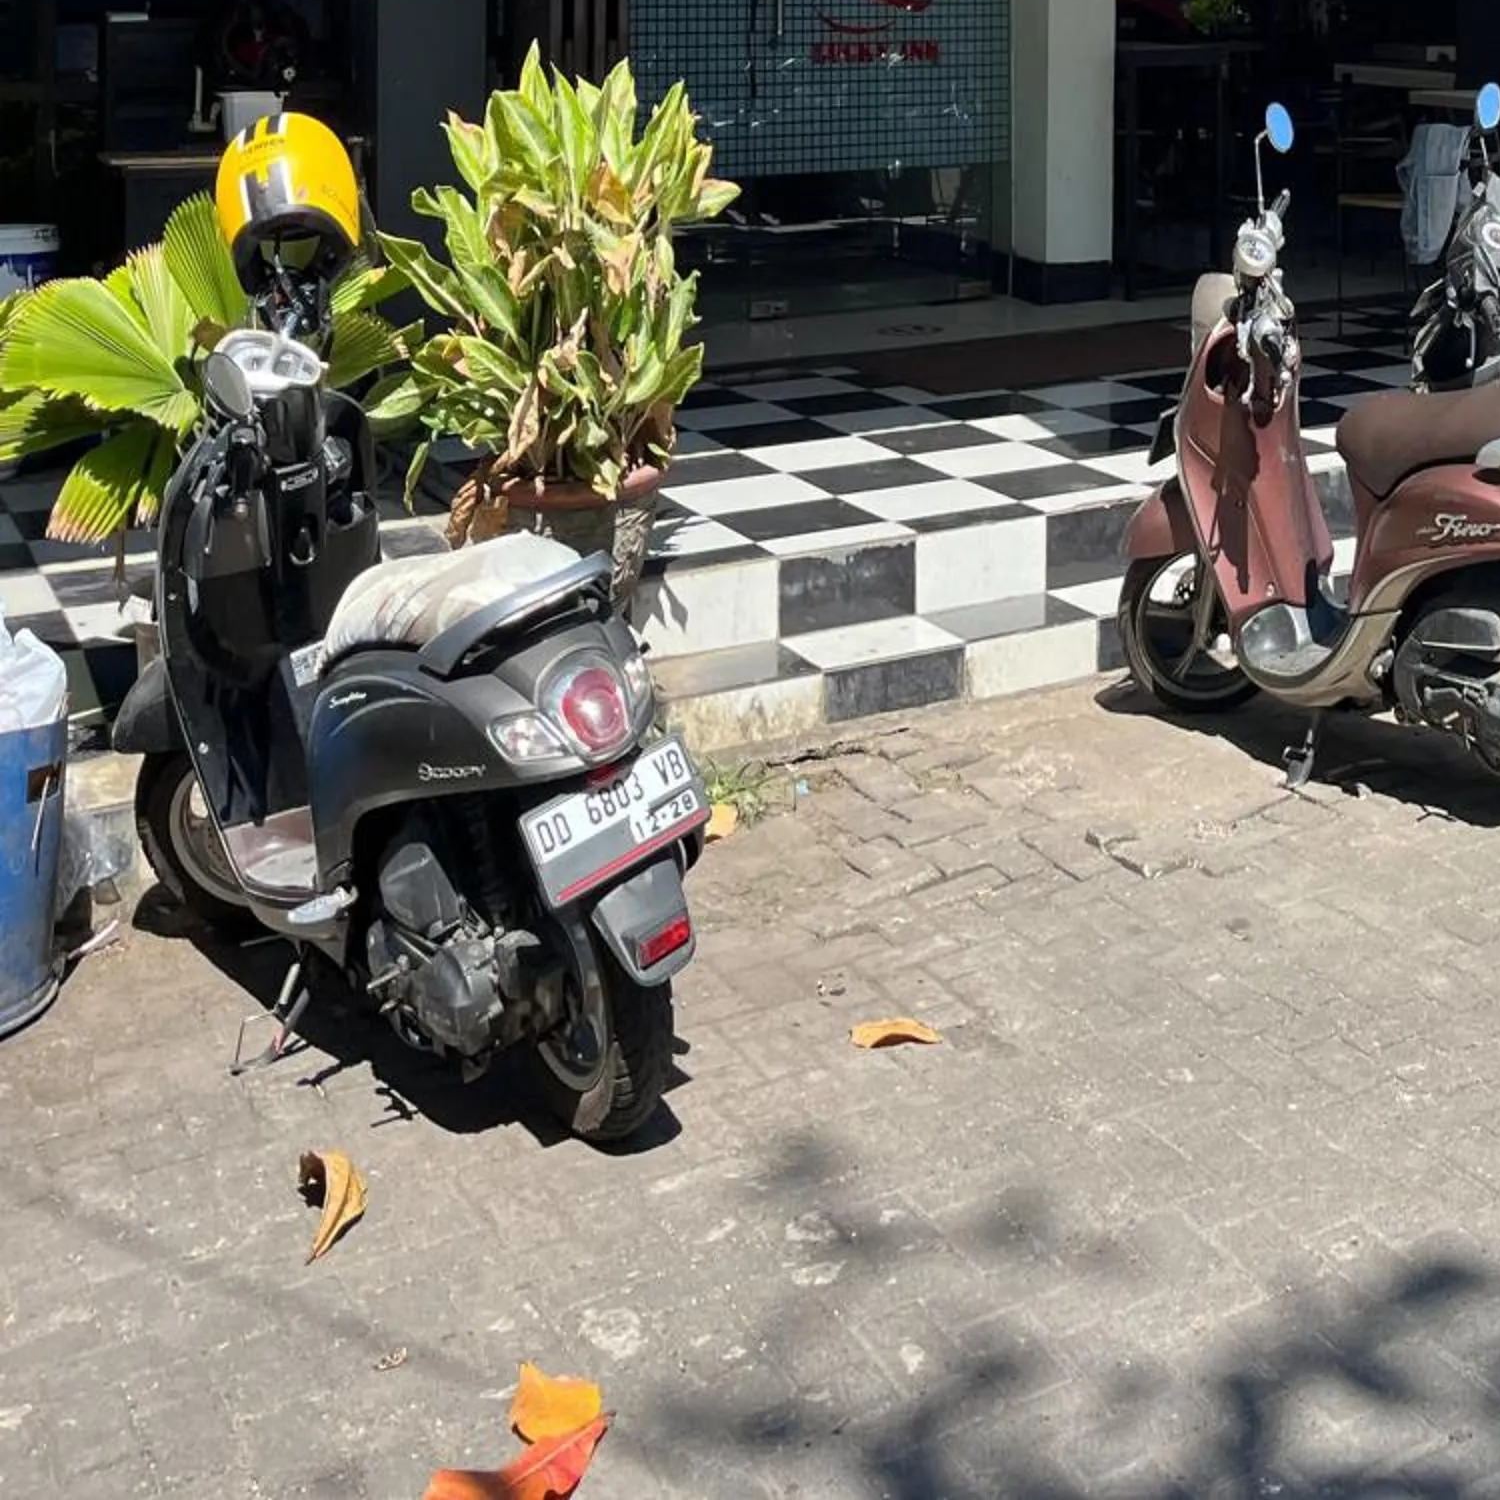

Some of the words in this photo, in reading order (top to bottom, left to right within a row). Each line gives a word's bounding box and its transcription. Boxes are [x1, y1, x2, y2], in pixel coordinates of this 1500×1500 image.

[535, 812, 573, 854] DD
[584, 772, 646, 826] 6803
[652, 748, 685, 786] VB
